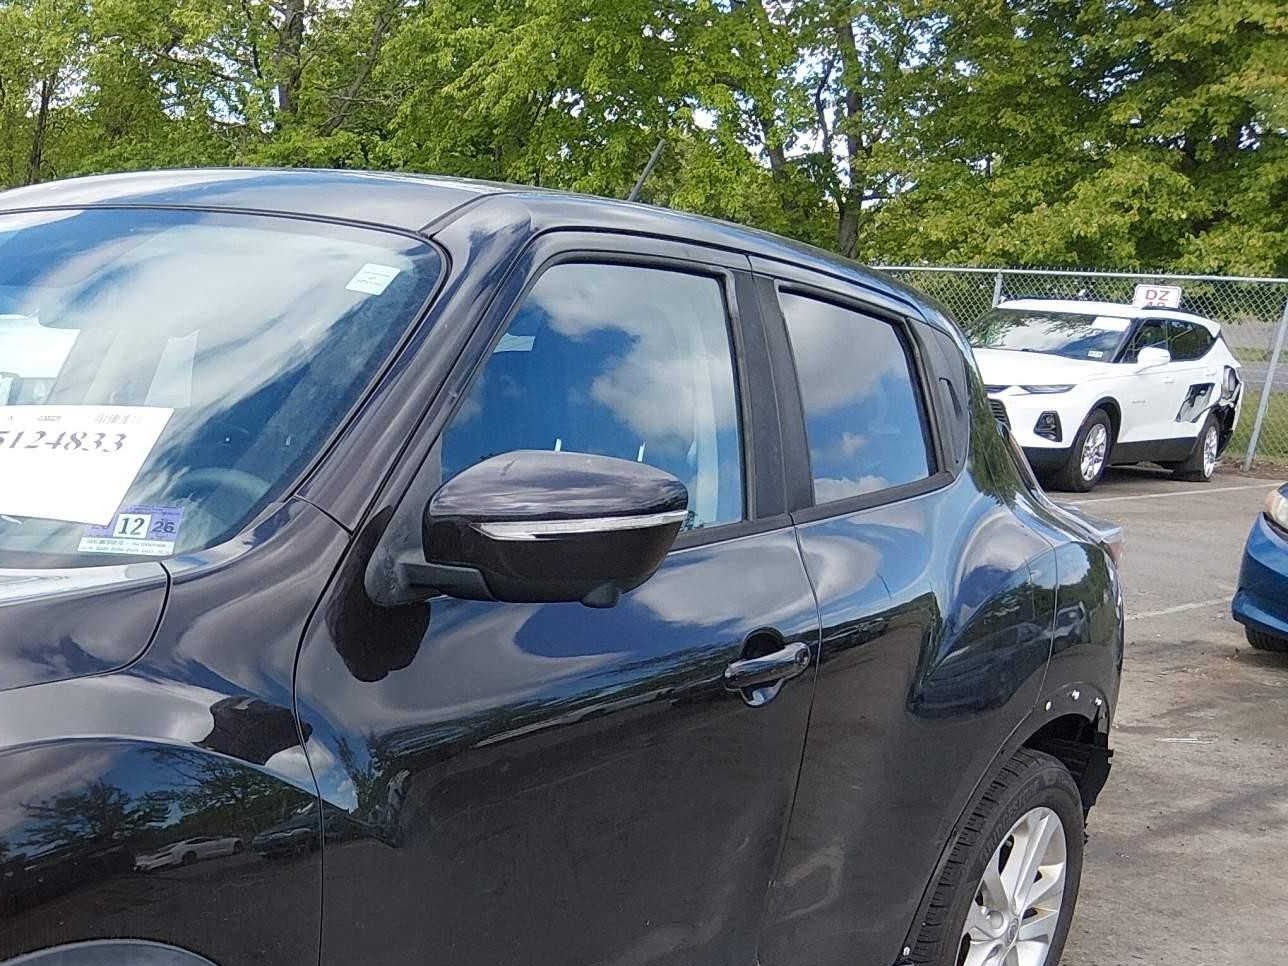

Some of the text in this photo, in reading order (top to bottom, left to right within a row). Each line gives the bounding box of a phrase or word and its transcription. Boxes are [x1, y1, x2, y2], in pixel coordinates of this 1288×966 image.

[1145, 289, 1170, 301] DZ
[118, 517, 146, 536] 12
[151, 520, 177, 535] 26
